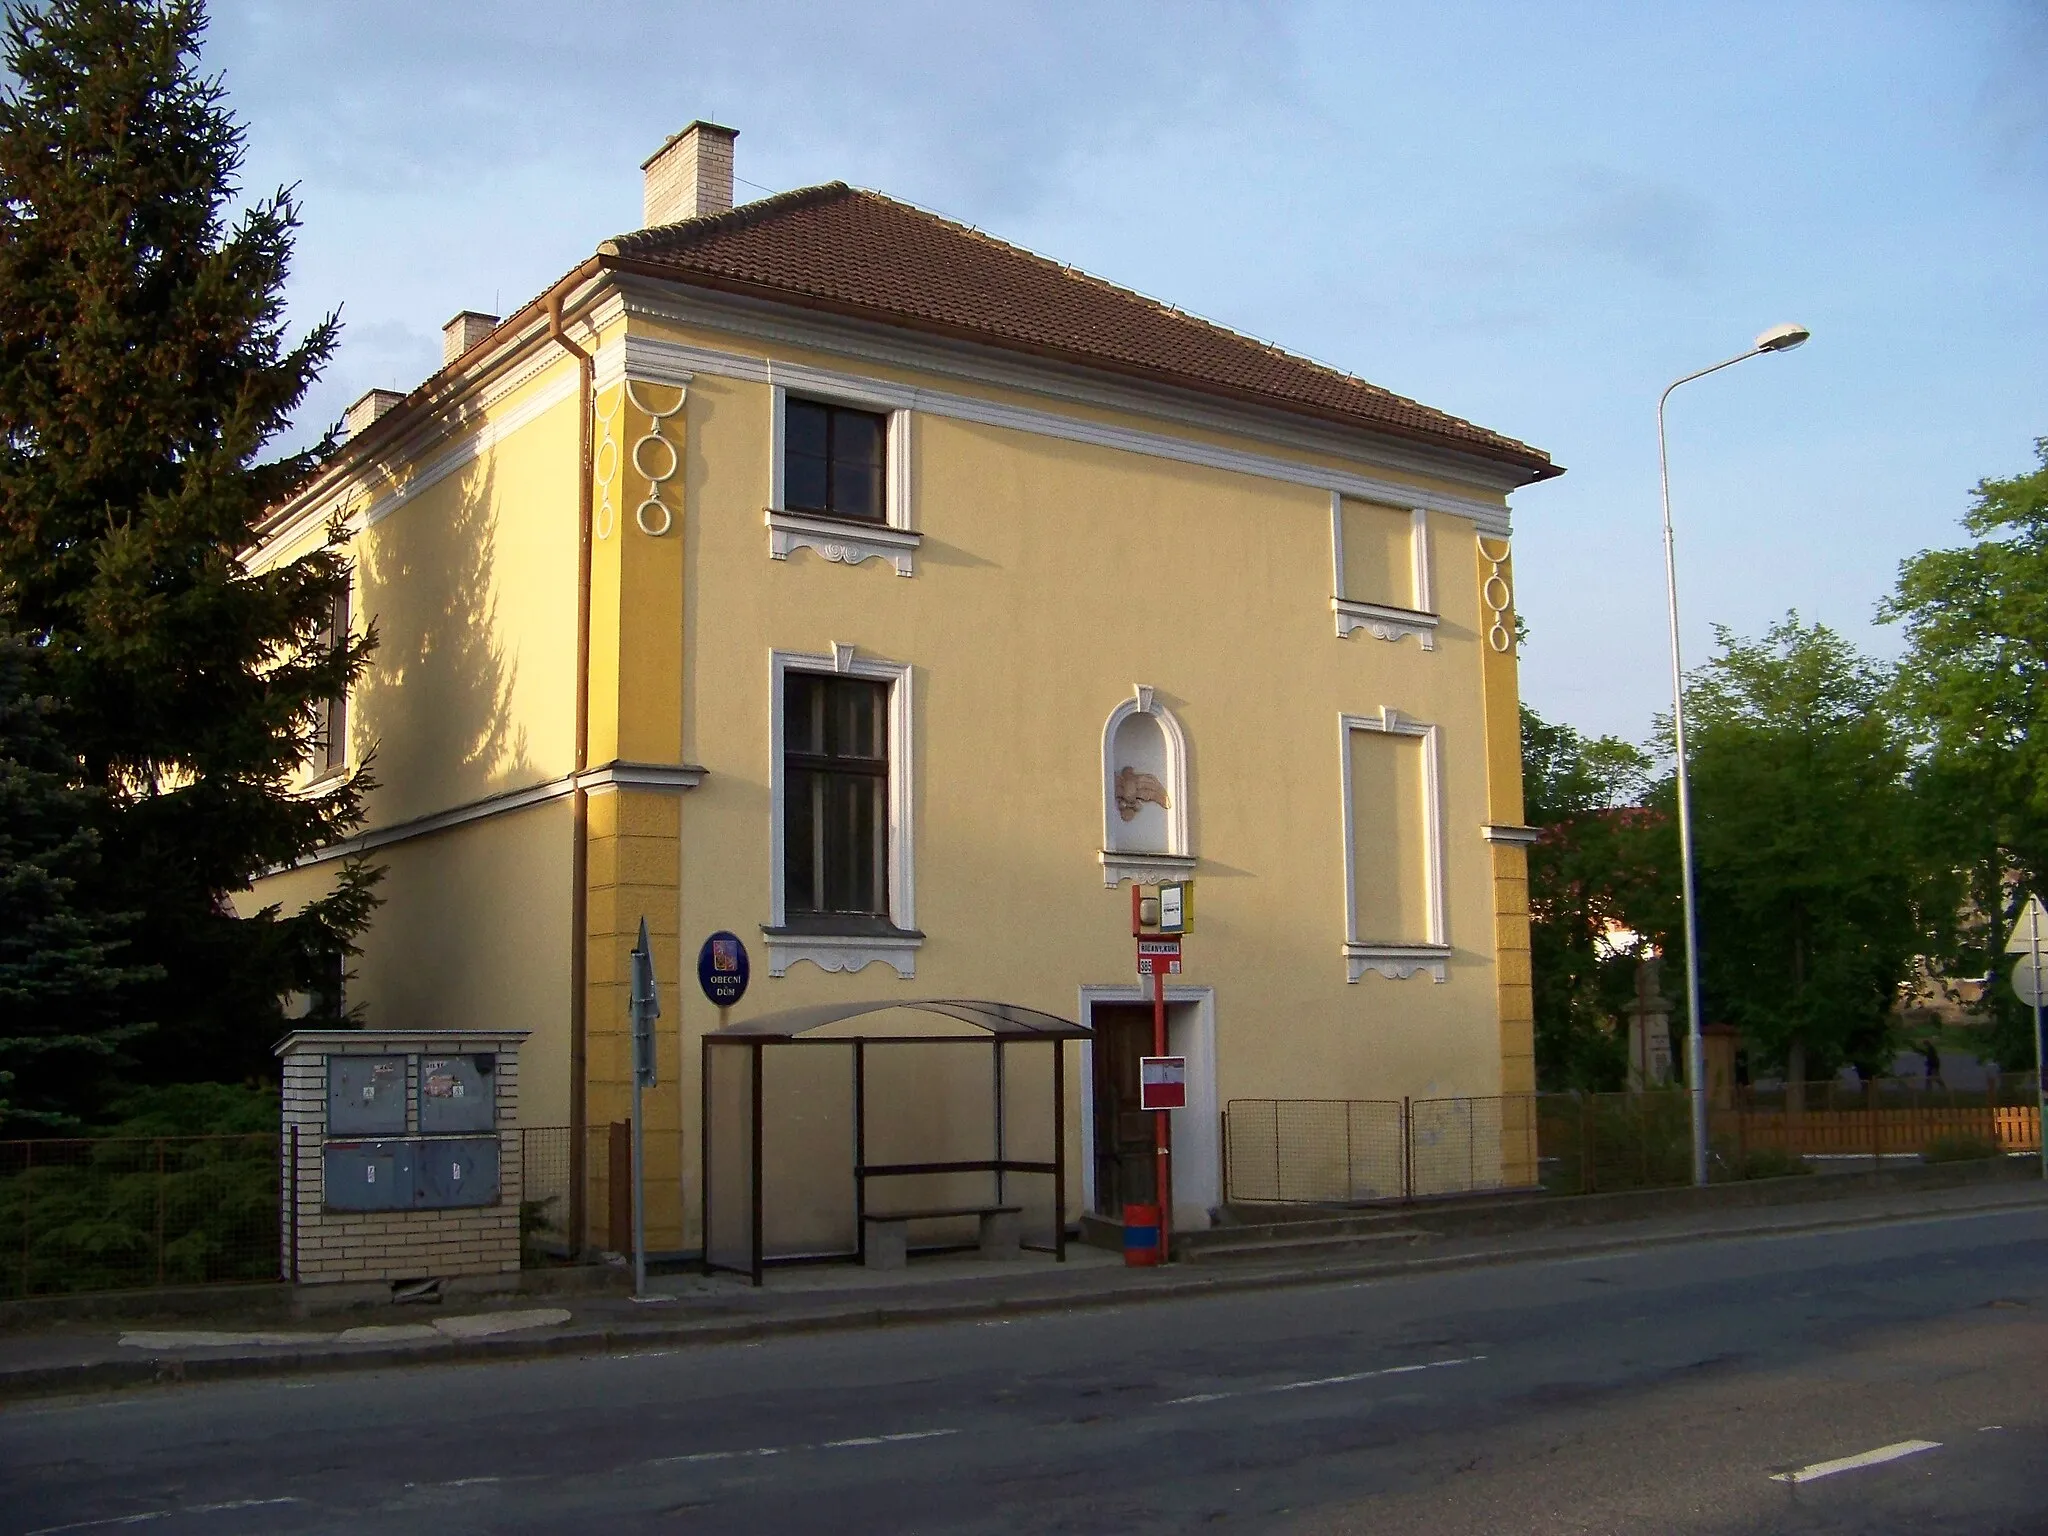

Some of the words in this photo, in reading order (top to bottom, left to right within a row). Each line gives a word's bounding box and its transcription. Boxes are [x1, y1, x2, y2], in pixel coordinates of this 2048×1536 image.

[1141, 960, 1151, 971] 385
[710, 974, 741, 984] OBECNÍ
[716, 986, 735, 996] DŮM
